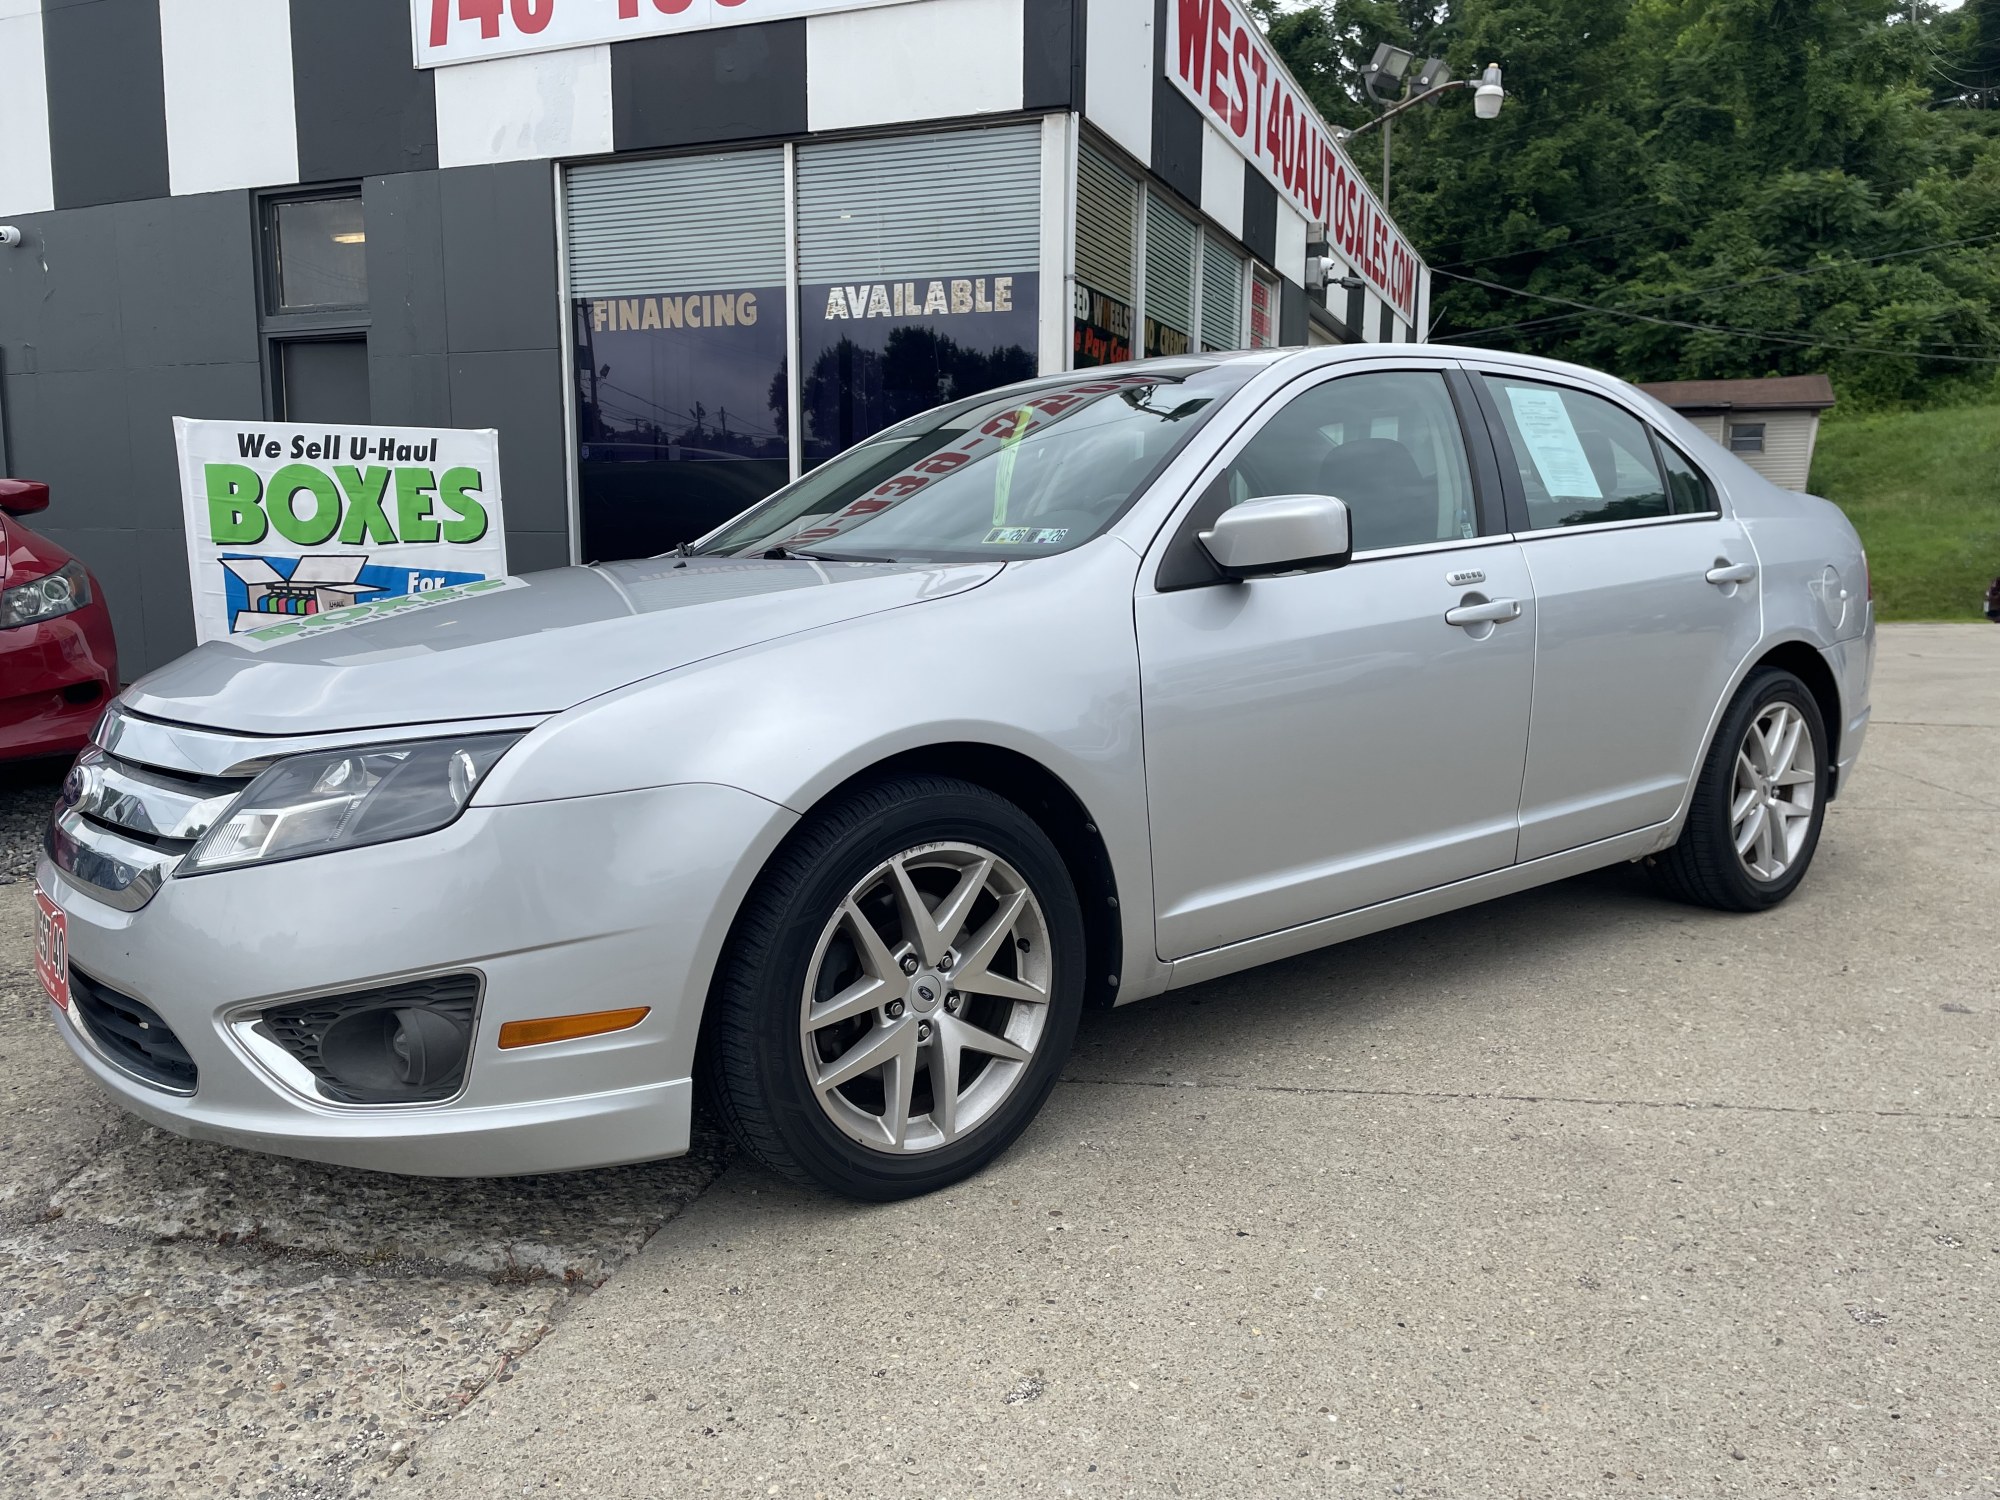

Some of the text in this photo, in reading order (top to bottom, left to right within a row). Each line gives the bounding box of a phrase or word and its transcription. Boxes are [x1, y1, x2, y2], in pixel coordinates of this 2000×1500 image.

[593, 276, 1013, 332] FINANCING AVAILABLE
[1074, 283, 1091, 321] EED
[237, 433, 438, 462] We Sell U-Haul
[204, 463, 489, 546] BOXES
[1010, 529, 1027, 541] 26
[1050, 529, 1067, 541] 26
[407, 571, 445, 594] For
[53, 922, 65, 984] 40
